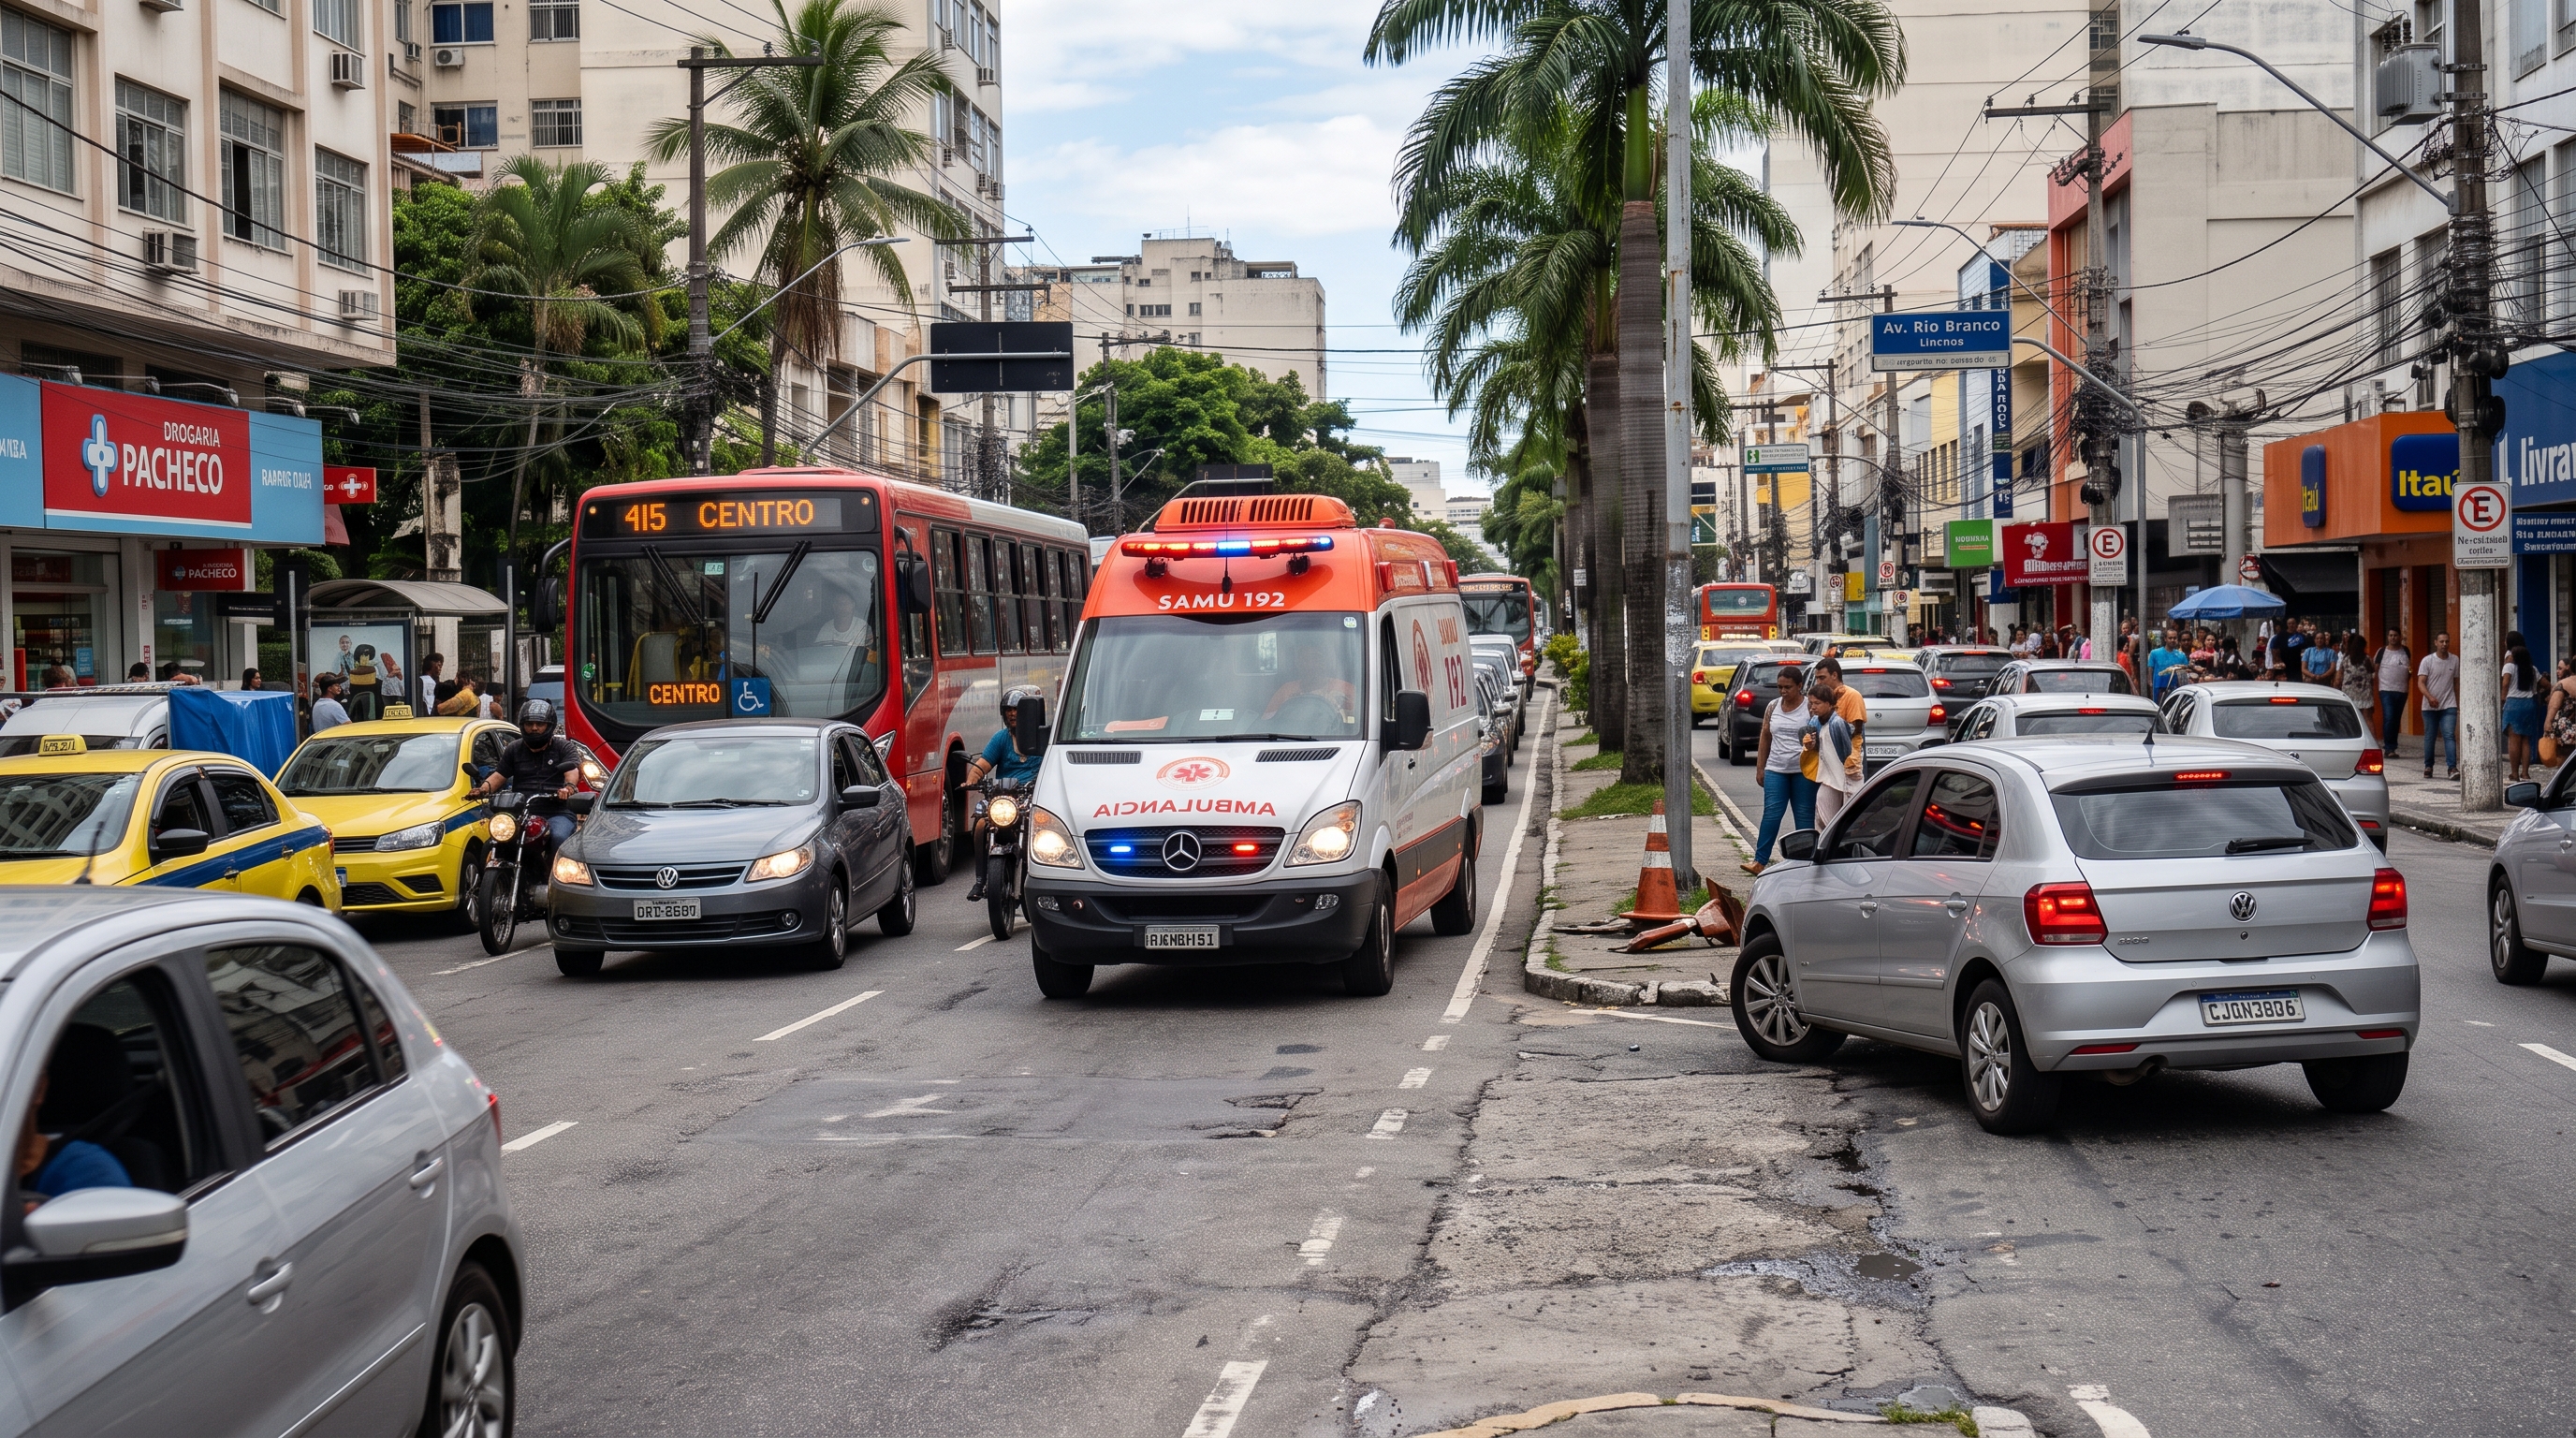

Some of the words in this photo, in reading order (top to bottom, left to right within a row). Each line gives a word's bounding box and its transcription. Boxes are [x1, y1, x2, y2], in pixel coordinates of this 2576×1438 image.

[1883, 322, 1908, 334] Av.
[1914, 320, 1939, 333] Rio
[1945, 320, 2000, 332] Branco
[1920, 338, 1964, 347] Lincnos
[164, 421, 221, 448] DROGARIA
[123, 443, 223, 495] PACHECO
[2302, 482, 2319, 513] Itaú
[625, 504, 666, 531] 415
[699, 499, 813, 527] CENTRO
[2102, 535, 2115, 552] E
[189, 568, 237, 579] PACHECO
[1158, 593, 1235, 610] SAMU
[1244, 592, 1285, 608] 192
[1444, 654, 1467, 710] 192
[650, 683, 721, 704] CENTRO
